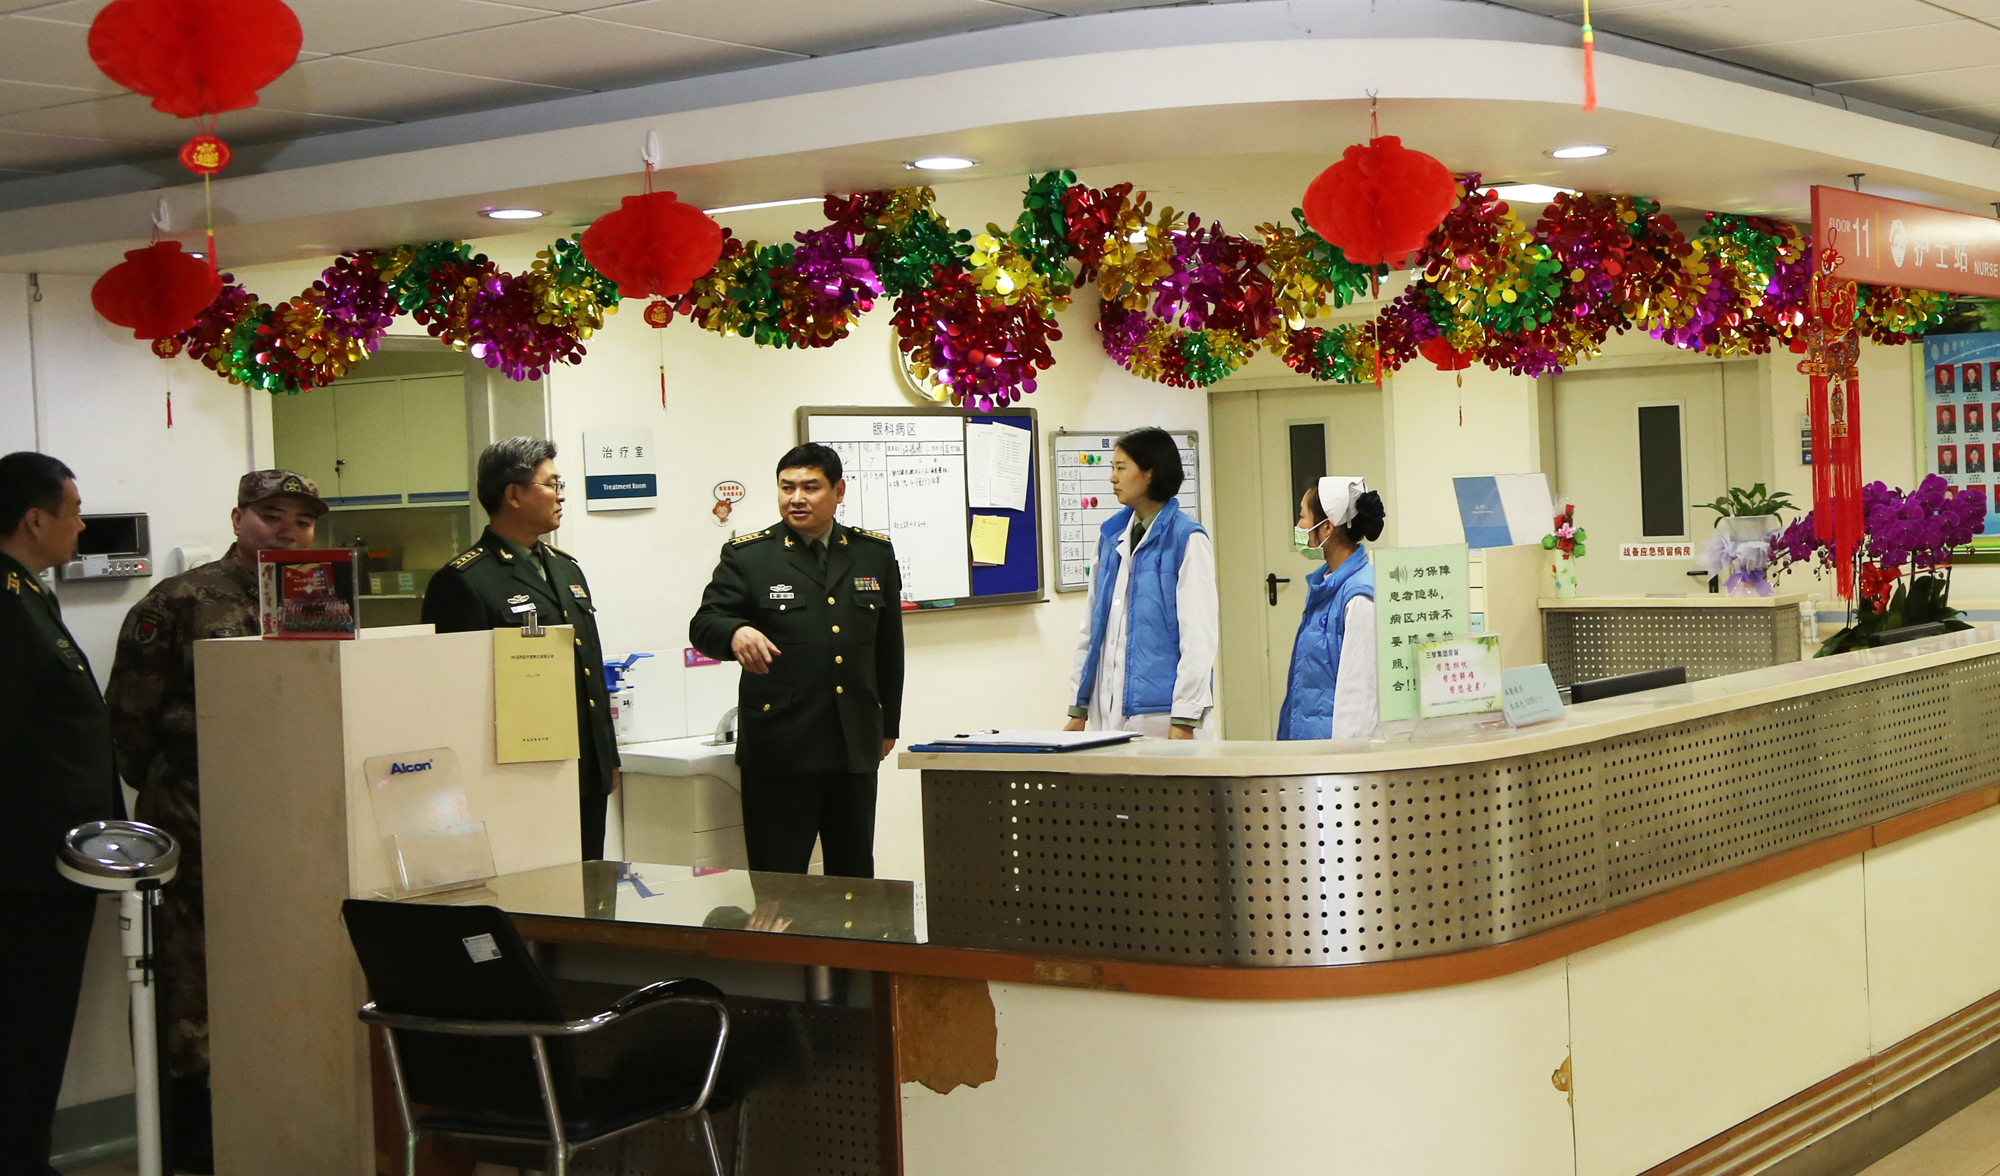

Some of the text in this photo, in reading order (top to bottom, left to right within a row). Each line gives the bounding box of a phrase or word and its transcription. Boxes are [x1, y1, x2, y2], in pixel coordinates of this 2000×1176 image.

[1829, 217, 1869, 257] FLOOR 11
[1914, 232, 1968, 273] 护士站
[1974, 260, 1999, 278] NURSE
[873, 422, 916, 437] 眼科病区
[602, 446, 644, 459] 治疗室
[603, 482, 647, 491] Treatment Room
[1623, 546, 1691, 557] 战备应急预留病房
[1413, 565, 1451, 578] 为保障
[1390, 609, 1453, 624] 病区内请不
[391, 761, 432, 775] Alcon
